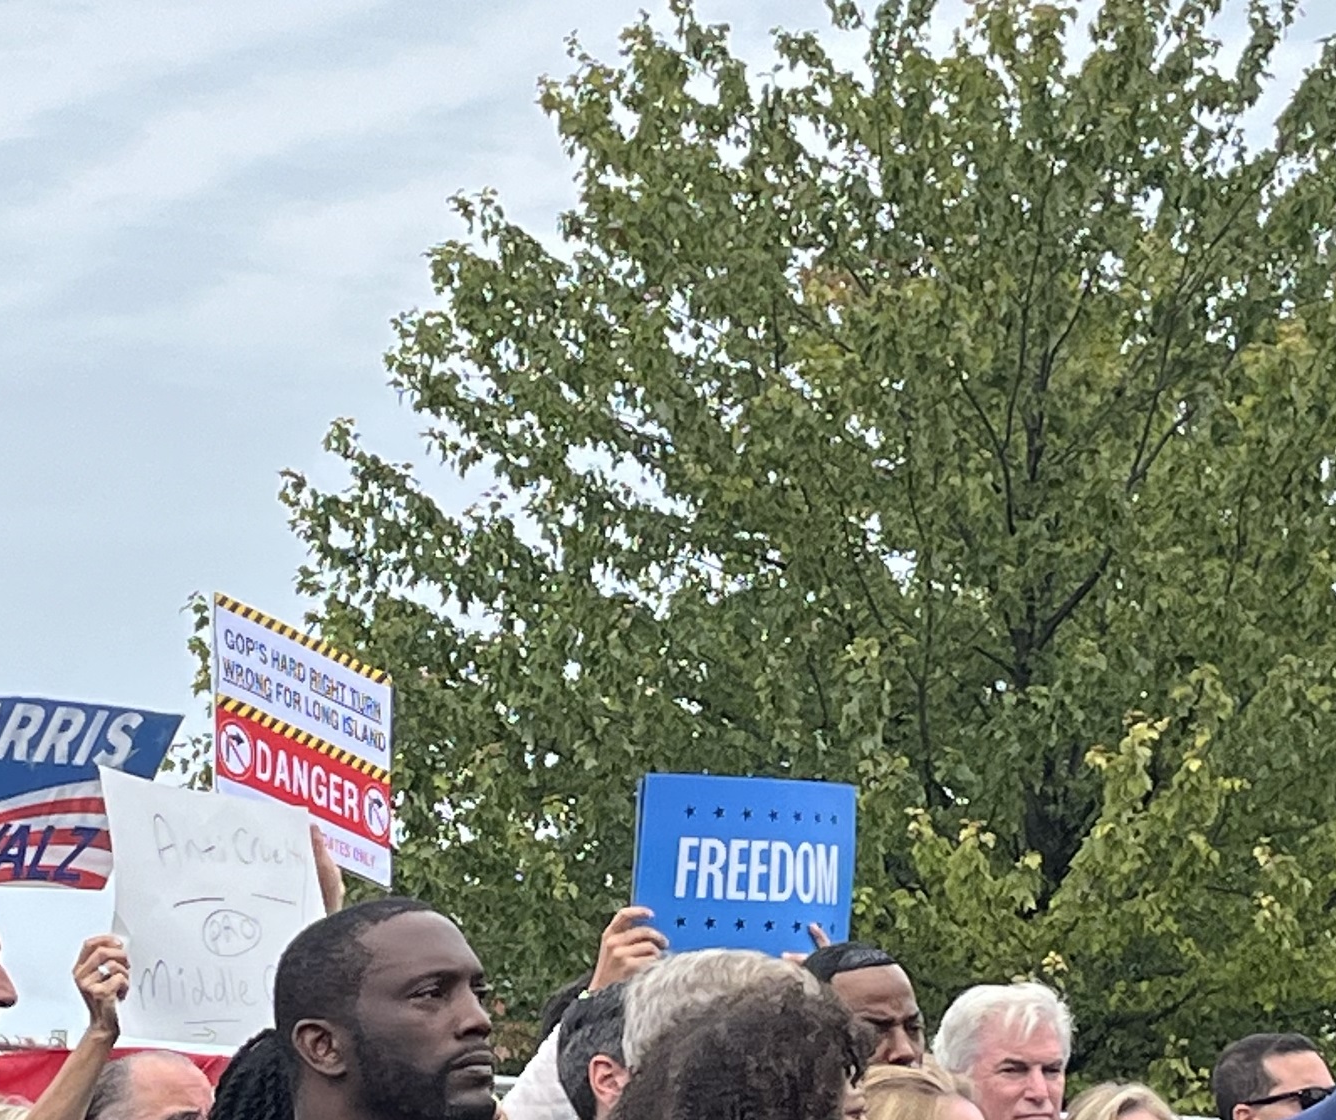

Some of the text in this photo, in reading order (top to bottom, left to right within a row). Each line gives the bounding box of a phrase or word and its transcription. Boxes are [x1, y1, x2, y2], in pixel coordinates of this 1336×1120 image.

[223, 656, 386, 752] WRONG FOR LONG ISLAND
[224, 628, 382, 721] GOP'S HARD RIGHT TURN
[255, 740, 360, 823] DANGER
[675, 837, 838, 905] FREEDOM
[138, 960, 257, 1010] Middle
